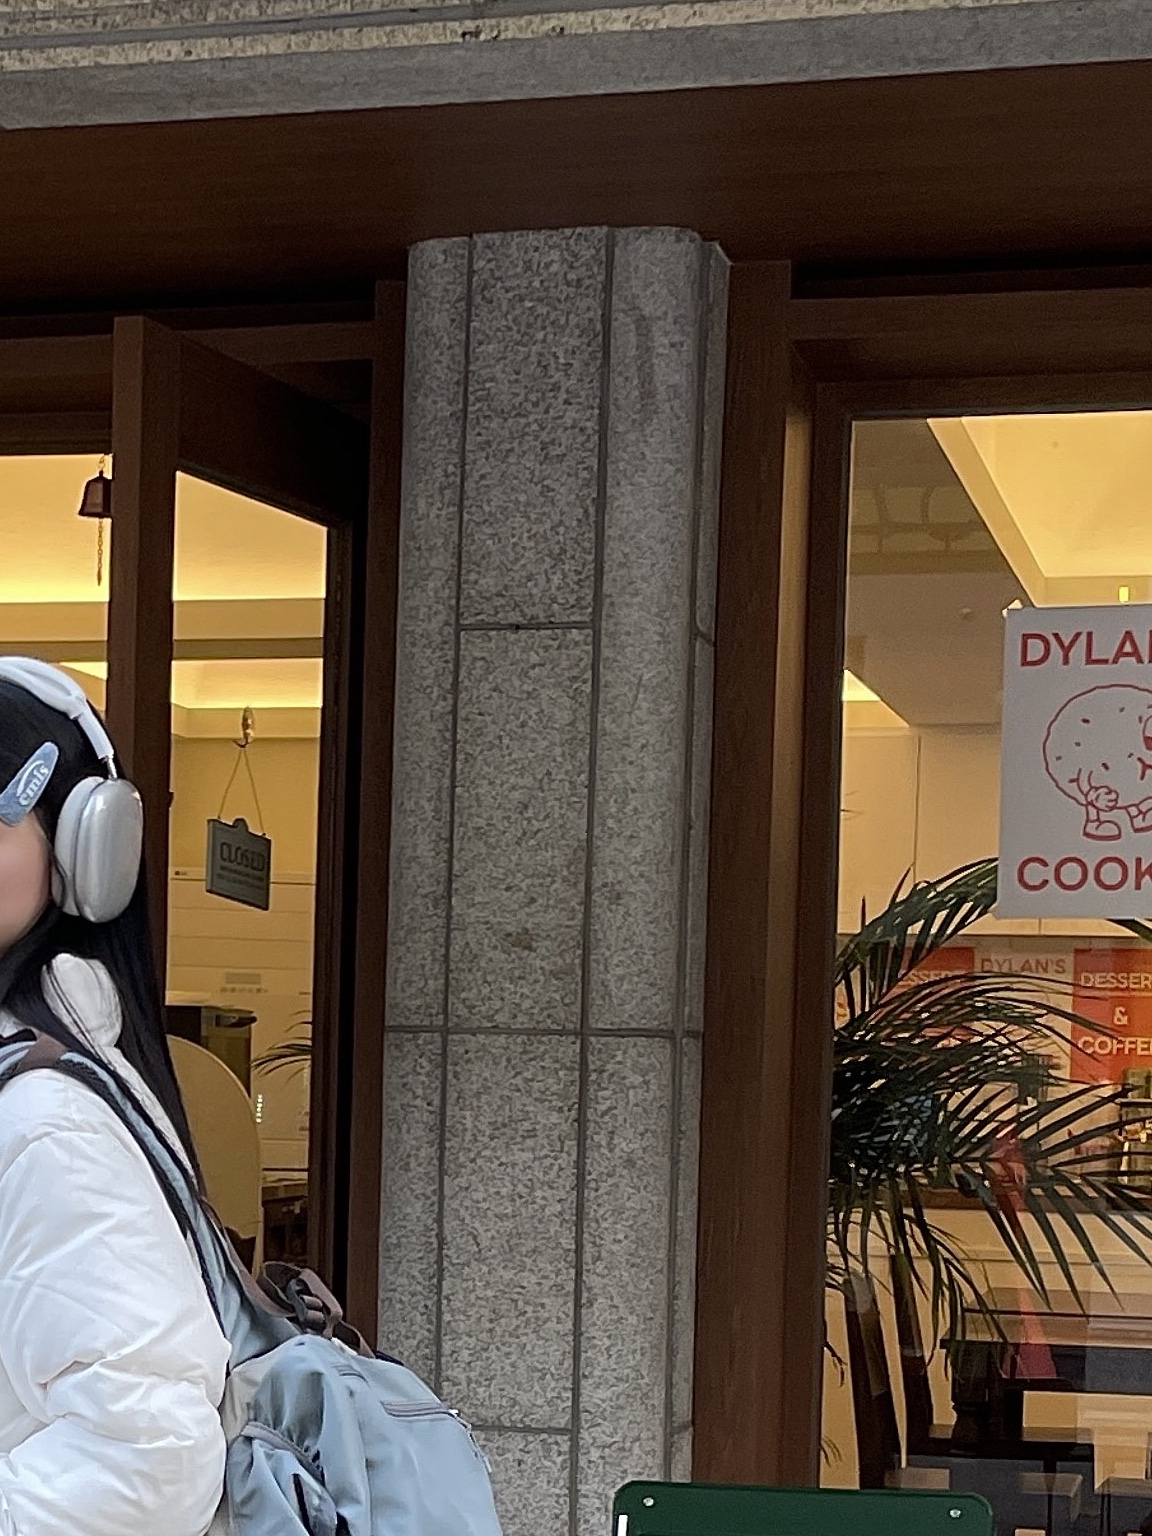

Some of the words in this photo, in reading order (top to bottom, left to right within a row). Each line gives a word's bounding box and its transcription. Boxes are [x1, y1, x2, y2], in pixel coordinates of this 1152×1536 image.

[1020, 630, 1152, 667] DYLA
[220, 842, 266, 872] CLOSED
[980, 958, 1066, 974] DYLAN'S
[1113, 1006, 1129, 1025] &
[1078, 1036, 1152, 1055] COFFE
